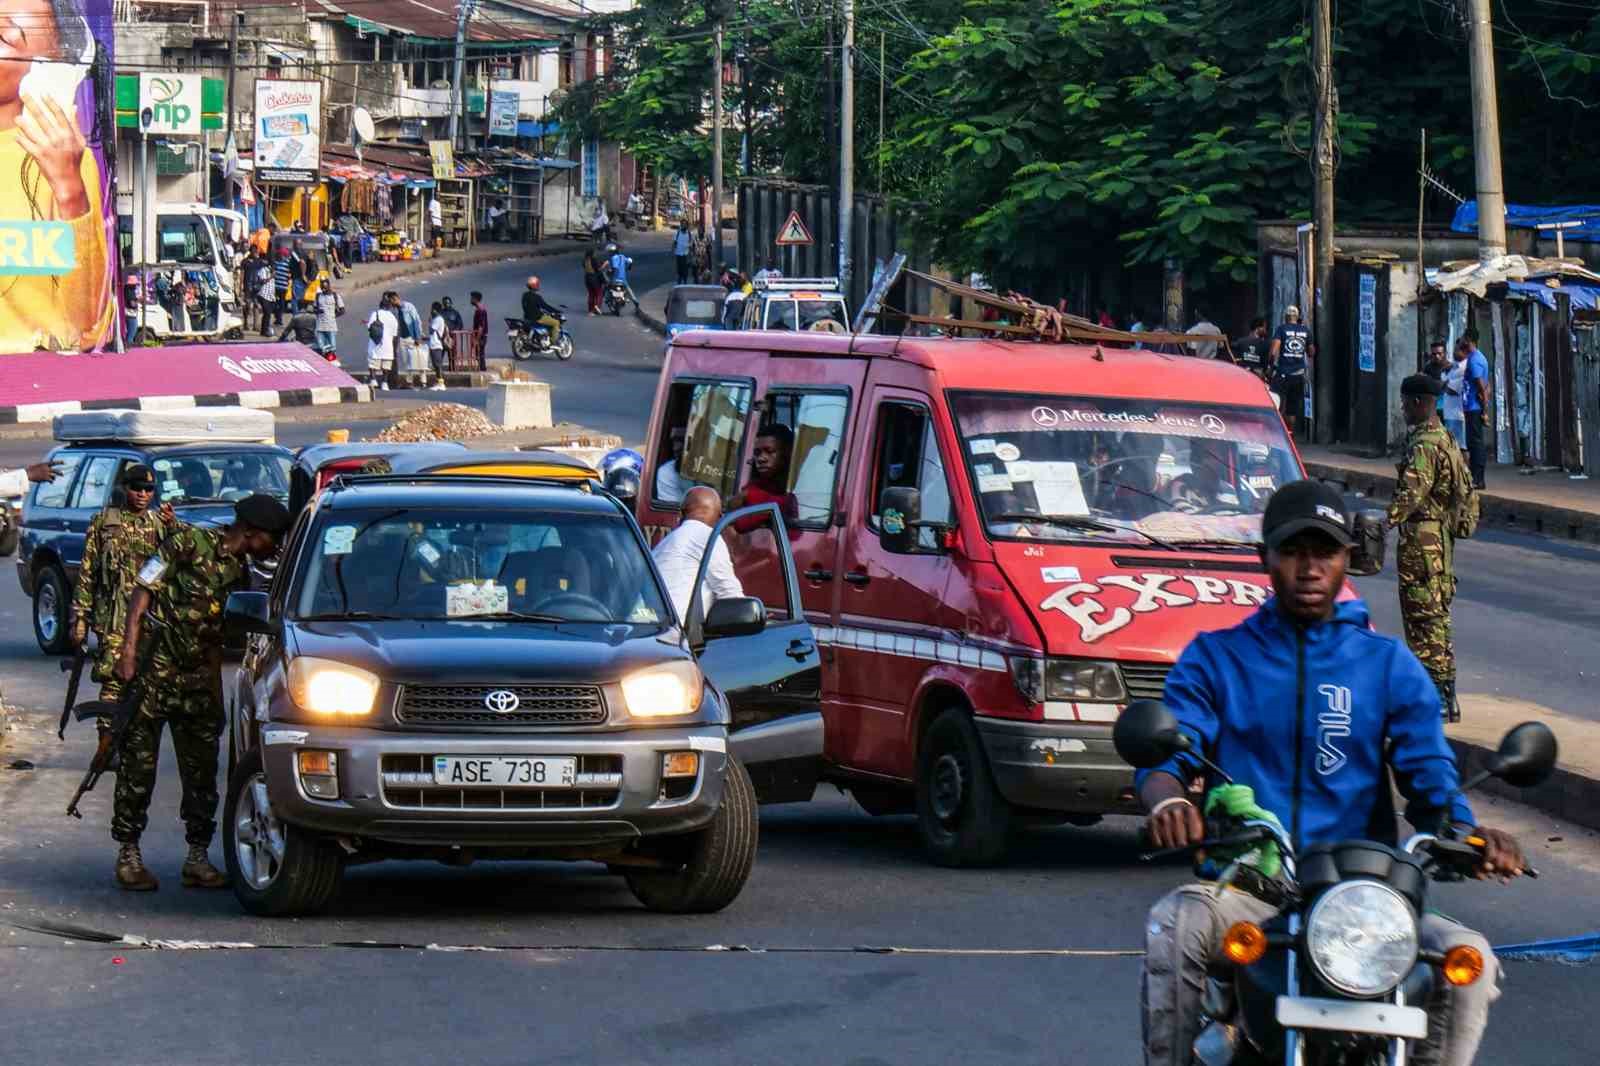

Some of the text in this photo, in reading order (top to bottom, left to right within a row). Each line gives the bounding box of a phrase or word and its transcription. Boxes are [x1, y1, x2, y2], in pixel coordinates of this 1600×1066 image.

[153, 102, 191, 130] np
[1040, 573, 1274, 643] EXPR
[1315, 684, 1351, 776] FILA
[451, 760, 546, 783] ASE 738
